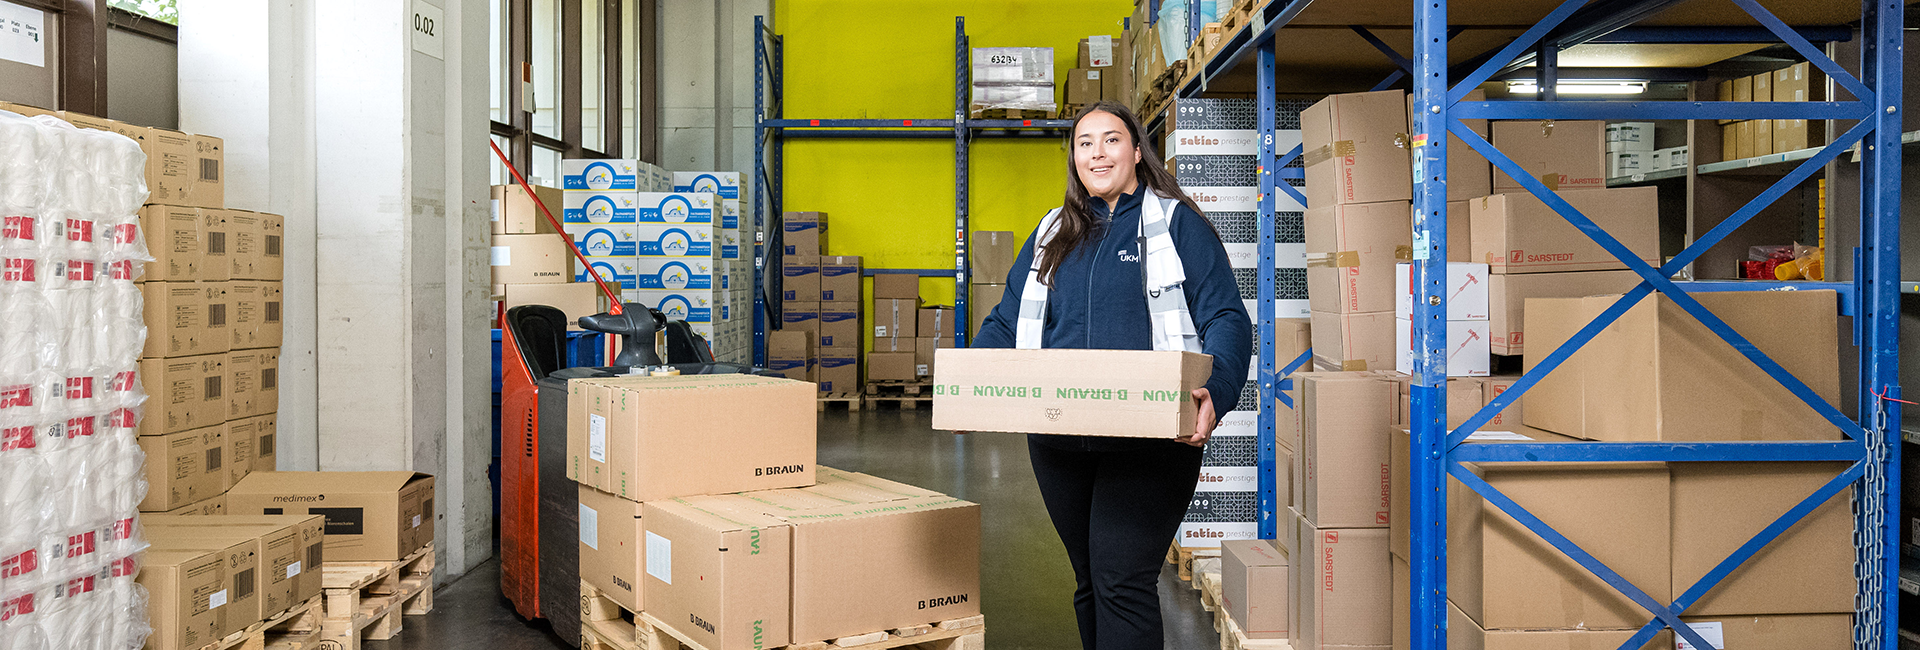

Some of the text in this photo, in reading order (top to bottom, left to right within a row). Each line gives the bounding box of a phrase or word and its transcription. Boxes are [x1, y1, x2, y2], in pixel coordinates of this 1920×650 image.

[415, 13, 434, 37] 0.02
[1180, 135, 1251, 146] satino prestige
[1264, 134, 1272, 145] 8
[1345, 167, 1354, 201] SARSTEDT
[1188, 192, 1250, 203] tino prestige
[1527, 253, 1574, 263] SARSTEDT
[1350, 278, 1358, 311] SARSTEDT
[973, 385, 1027, 398] BRAUN
[1056, 387, 1112, 400] BRAUN
[1225, 419, 1255, 428] prestige
[755, 464, 804, 476] B BRAUN
[1199, 473, 1256, 483] tino prestige
[1381, 462, 1389, 508] SARSTEDT
[273, 494, 317, 503] medimex
[1185, 528, 1256, 539] satino prestige
[1325, 547, 1333, 592] SARSTEDT
[617, 577, 632, 593] BRAUN
[918, 593, 968, 610] B BRAUN
[690, 613, 716, 635] B BRAUN
